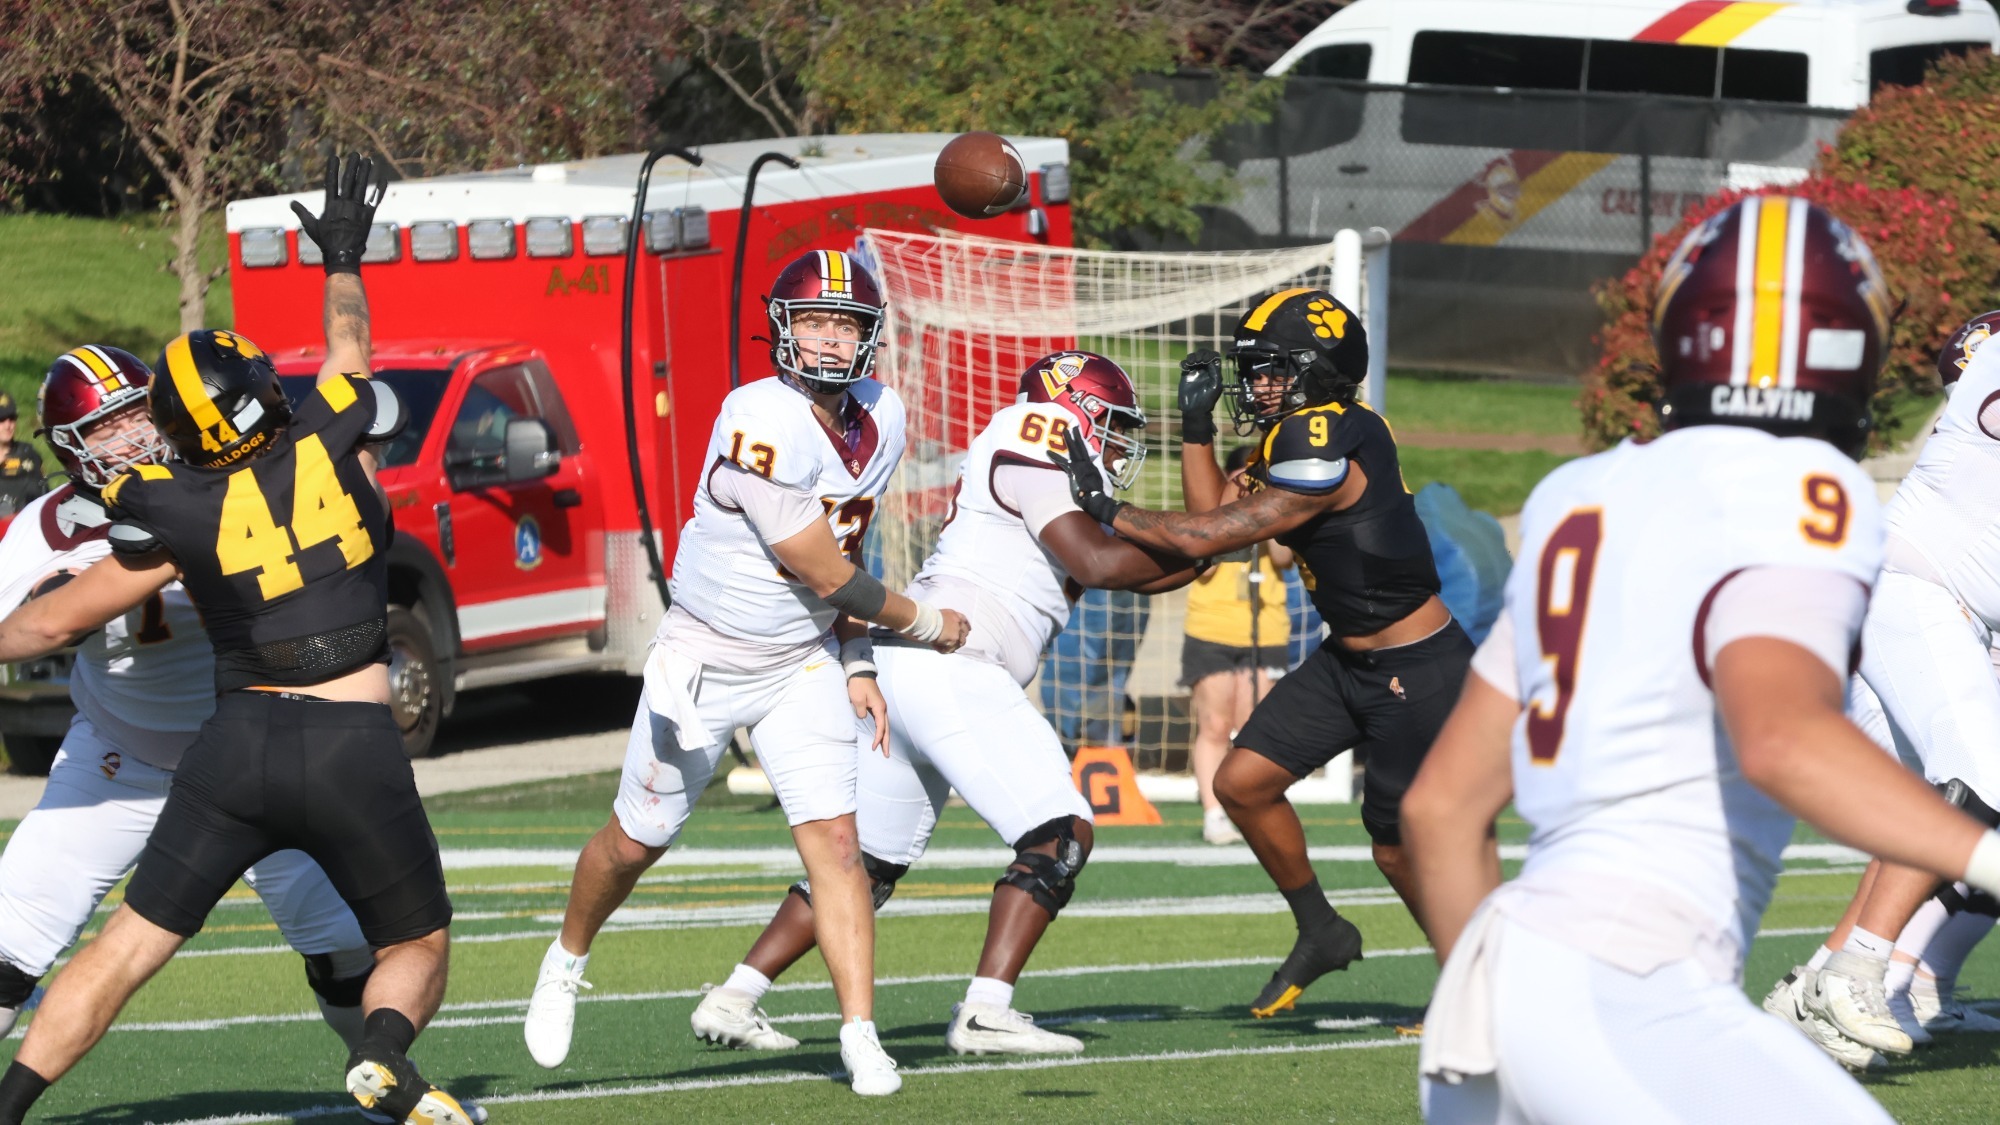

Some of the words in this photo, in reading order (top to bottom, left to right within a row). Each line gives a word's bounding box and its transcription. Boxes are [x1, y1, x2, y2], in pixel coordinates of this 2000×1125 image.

[546, 264, 610, 296] A-41
[821, 290, 853, 300] Riddell
[1711, 384, 1816, 422] CALVIN
[201, 418, 240, 454] 44
[1308, 415, 1329, 447] 9
[730, 429, 777, 480] 13
[216, 432, 375, 602] 44
[1798, 471, 1852, 550] 9
[1525, 505, 1604, 767] 9
[1081, 761, 1121, 816] G
